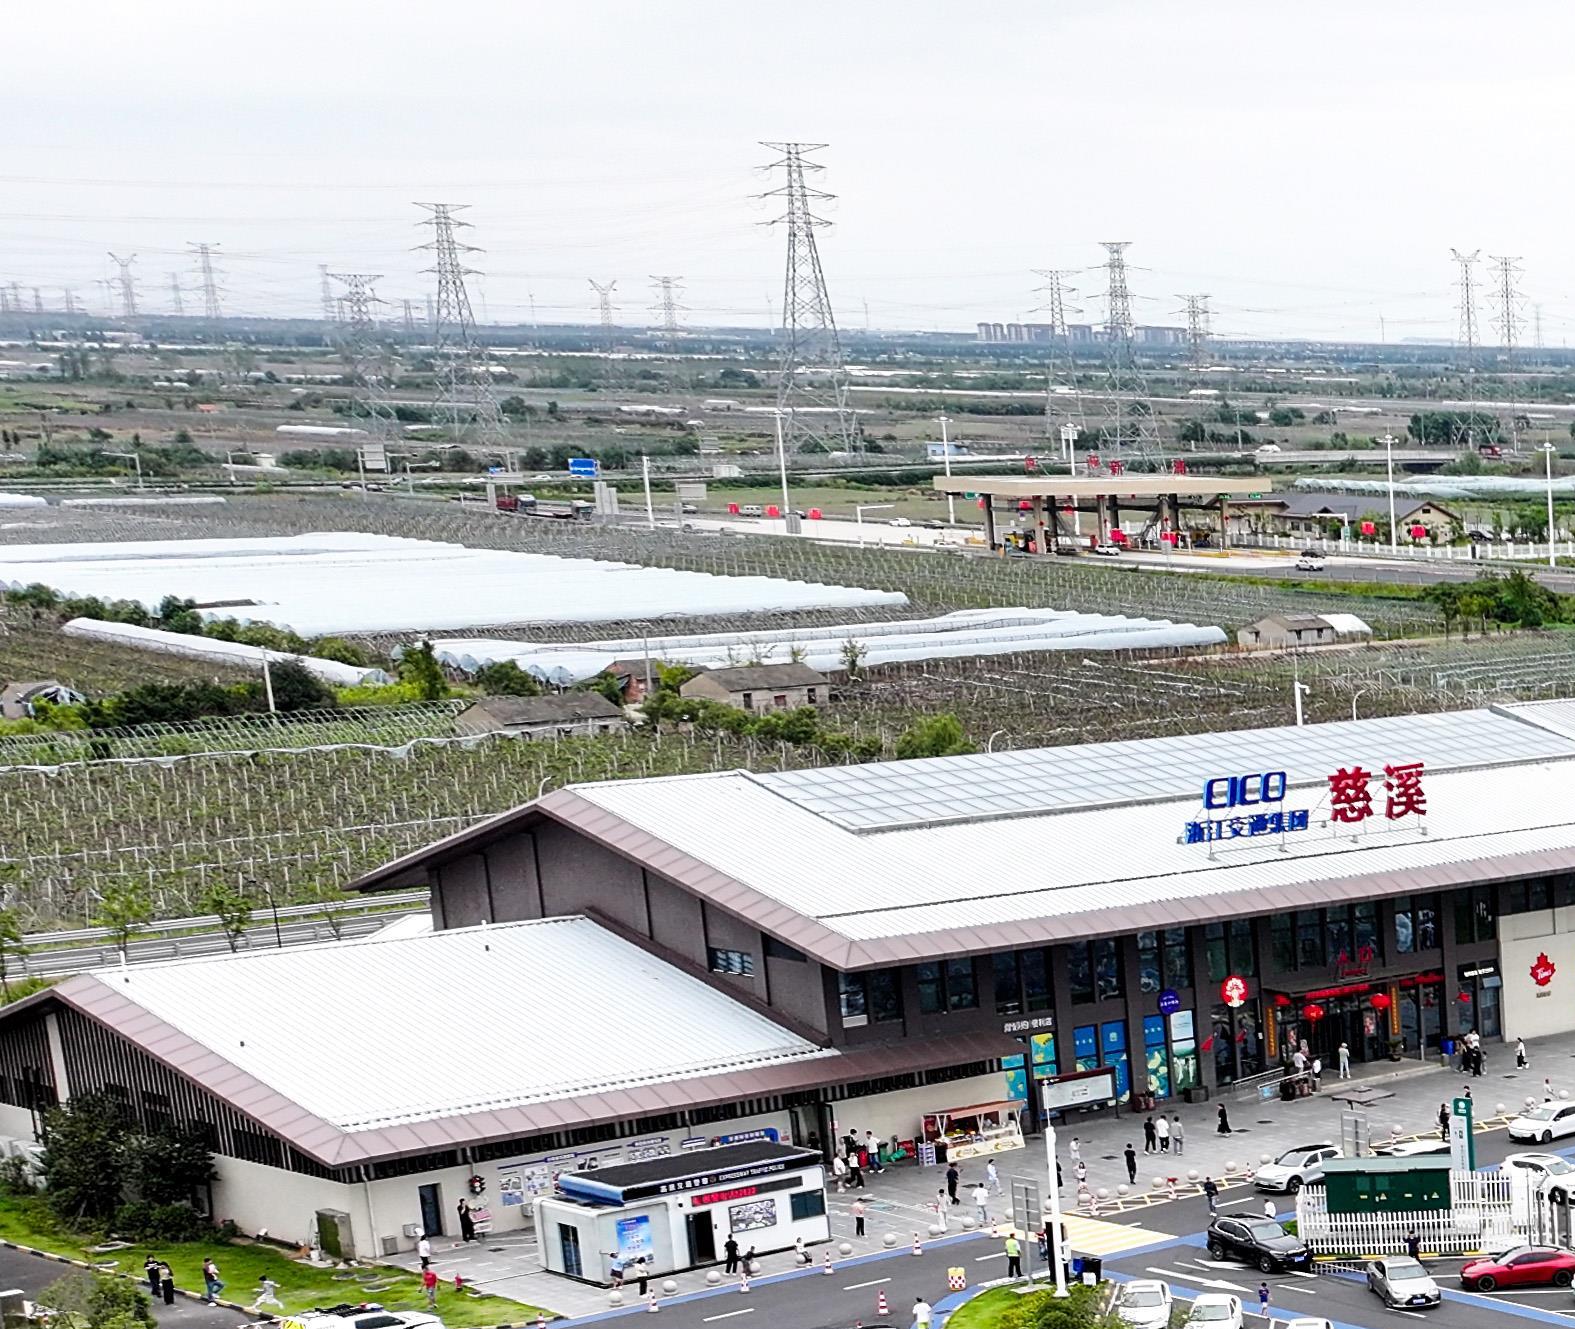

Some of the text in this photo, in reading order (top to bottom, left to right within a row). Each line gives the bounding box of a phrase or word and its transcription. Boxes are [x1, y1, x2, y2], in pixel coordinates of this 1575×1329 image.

[1328, 763, 1427, 823] 慈溪
[1184, 809, 1309, 844] 浙江交通集团
